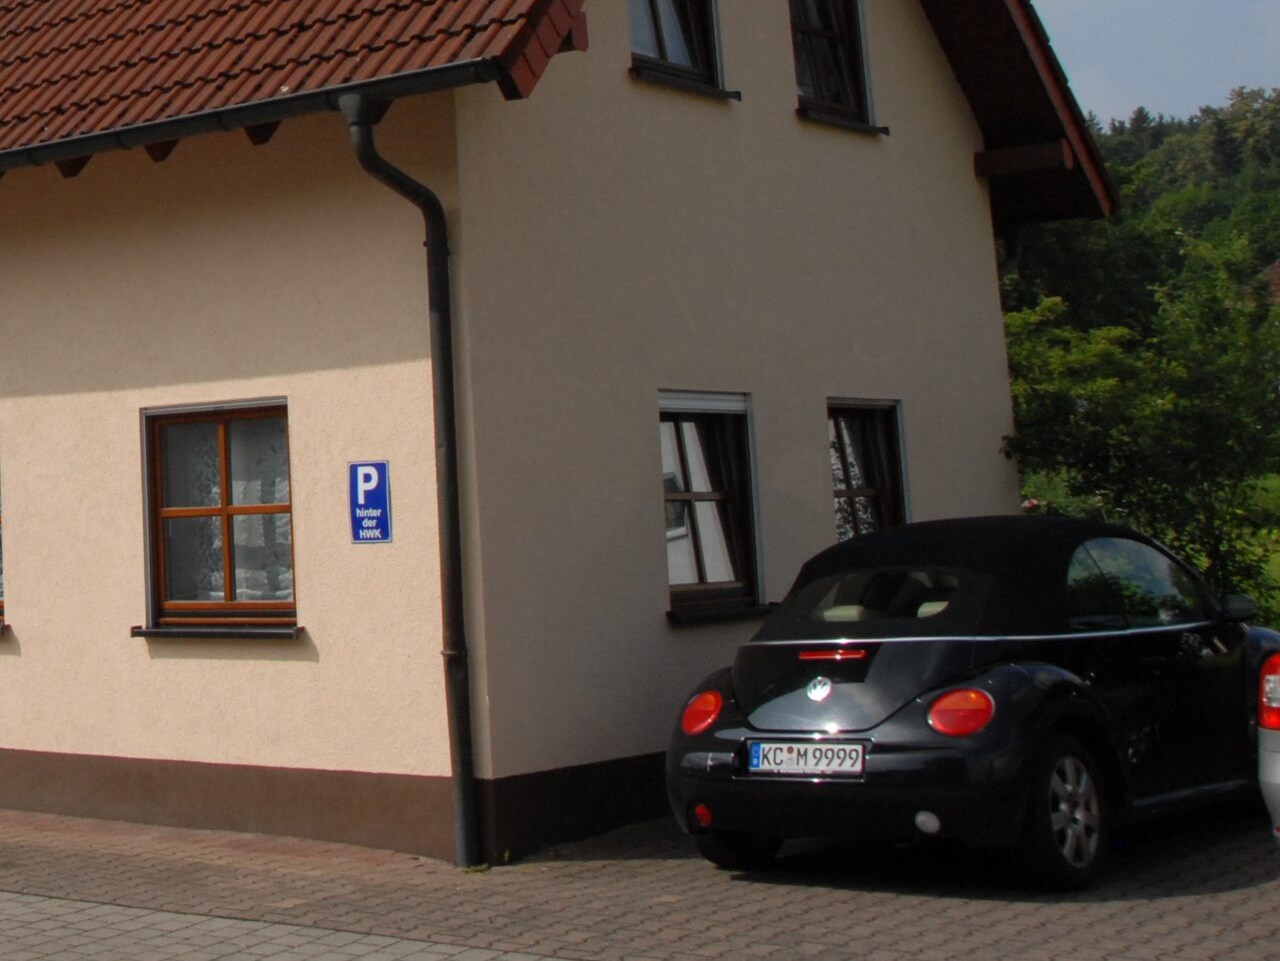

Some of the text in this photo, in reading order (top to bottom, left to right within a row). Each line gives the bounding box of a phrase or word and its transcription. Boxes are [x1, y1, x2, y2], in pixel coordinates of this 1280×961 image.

[357, 465, 379, 505] P
[356, 507, 382, 518] hinter
[362, 518, 377, 528] der
[359, 529, 382, 539] HWK
[761, 747, 860, 768] KC M 9999
